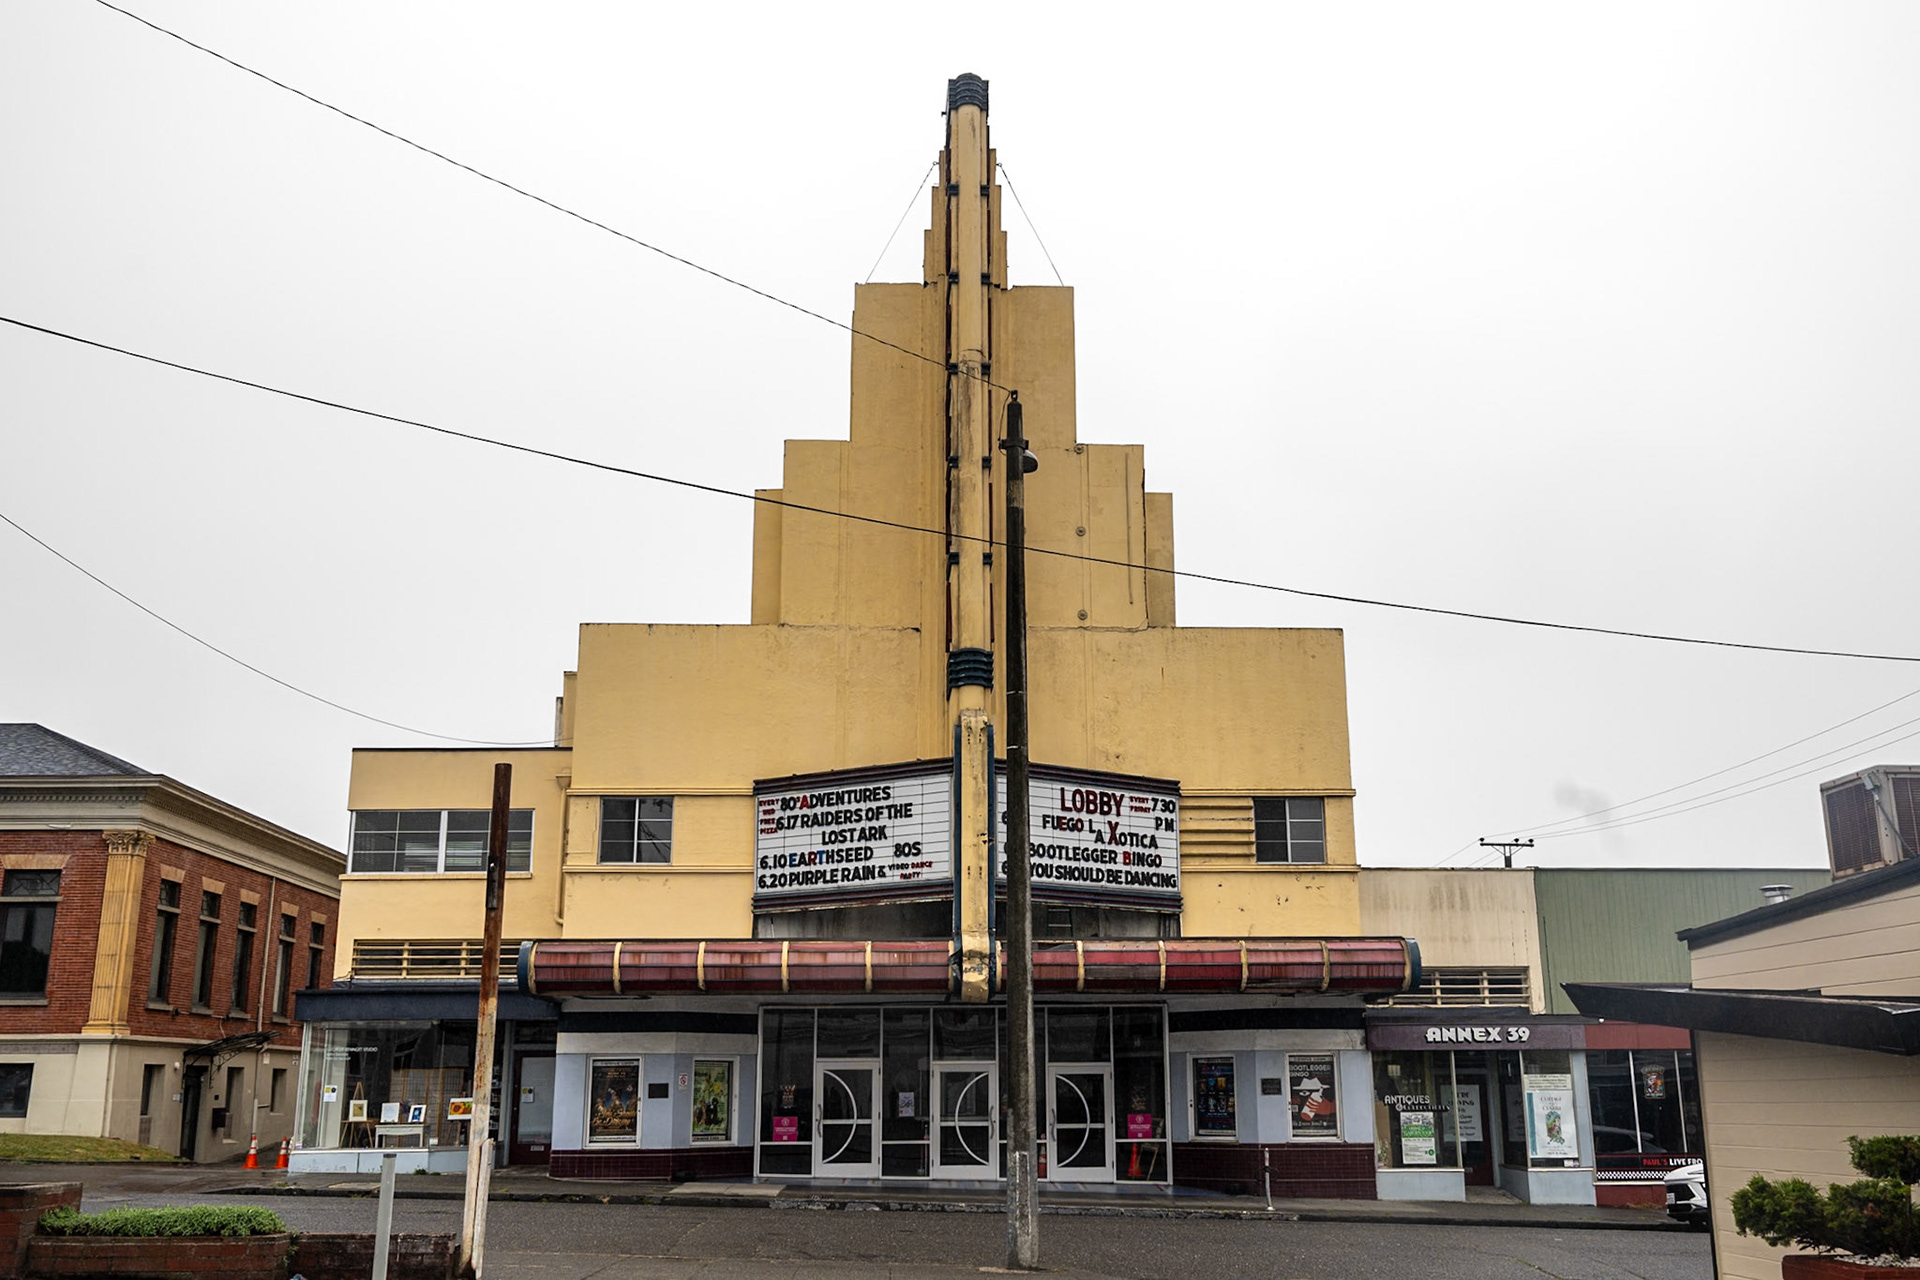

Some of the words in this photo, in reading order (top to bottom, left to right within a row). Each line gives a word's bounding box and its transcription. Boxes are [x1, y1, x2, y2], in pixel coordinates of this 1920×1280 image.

[799, 786, 892, 810] ADVENTURES
[1060, 787, 1125, 817] LOBBY
[800, 808, 863, 829] RAIDERS
[865, 806, 883, 824] OF
[883, 803, 913, 821] THE
[1042, 814, 1085, 832] FUEGO
[821, 828, 856, 846] LOST
[857, 825, 888, 842] ARK
[759, 853, 788, 870] 6.10
[788, 846, 874, 867] EARTHSEED
[894, 841, 921, 858] 80S
[888, 862, 910, 871] VIDEO
[1122, 851, 1162, 868] BINGO
[758, 873, 788, 889] 6.20
[789, 868, 839, 887] PURPLE
[840, 864, 876, 883] RAIN
[877, 865, 887, 878] &
[899, 871, 921, 880] PARTY
[1054, 864, 1105, 883] SHOULD
[1106, 868, 1124, 885] BE
[1124, 870, 1177, 889] DANCING
[1425, 1027, 1502, 1043] ANNEX
[1507, 1027, 1530, 1043] 39
[1384, 1095, 1430, 1105] ANTIQUES
[1643, 1158, 1668, 1166] PAUL'S
[1669, 1158, 1686, 1166] LIVE
